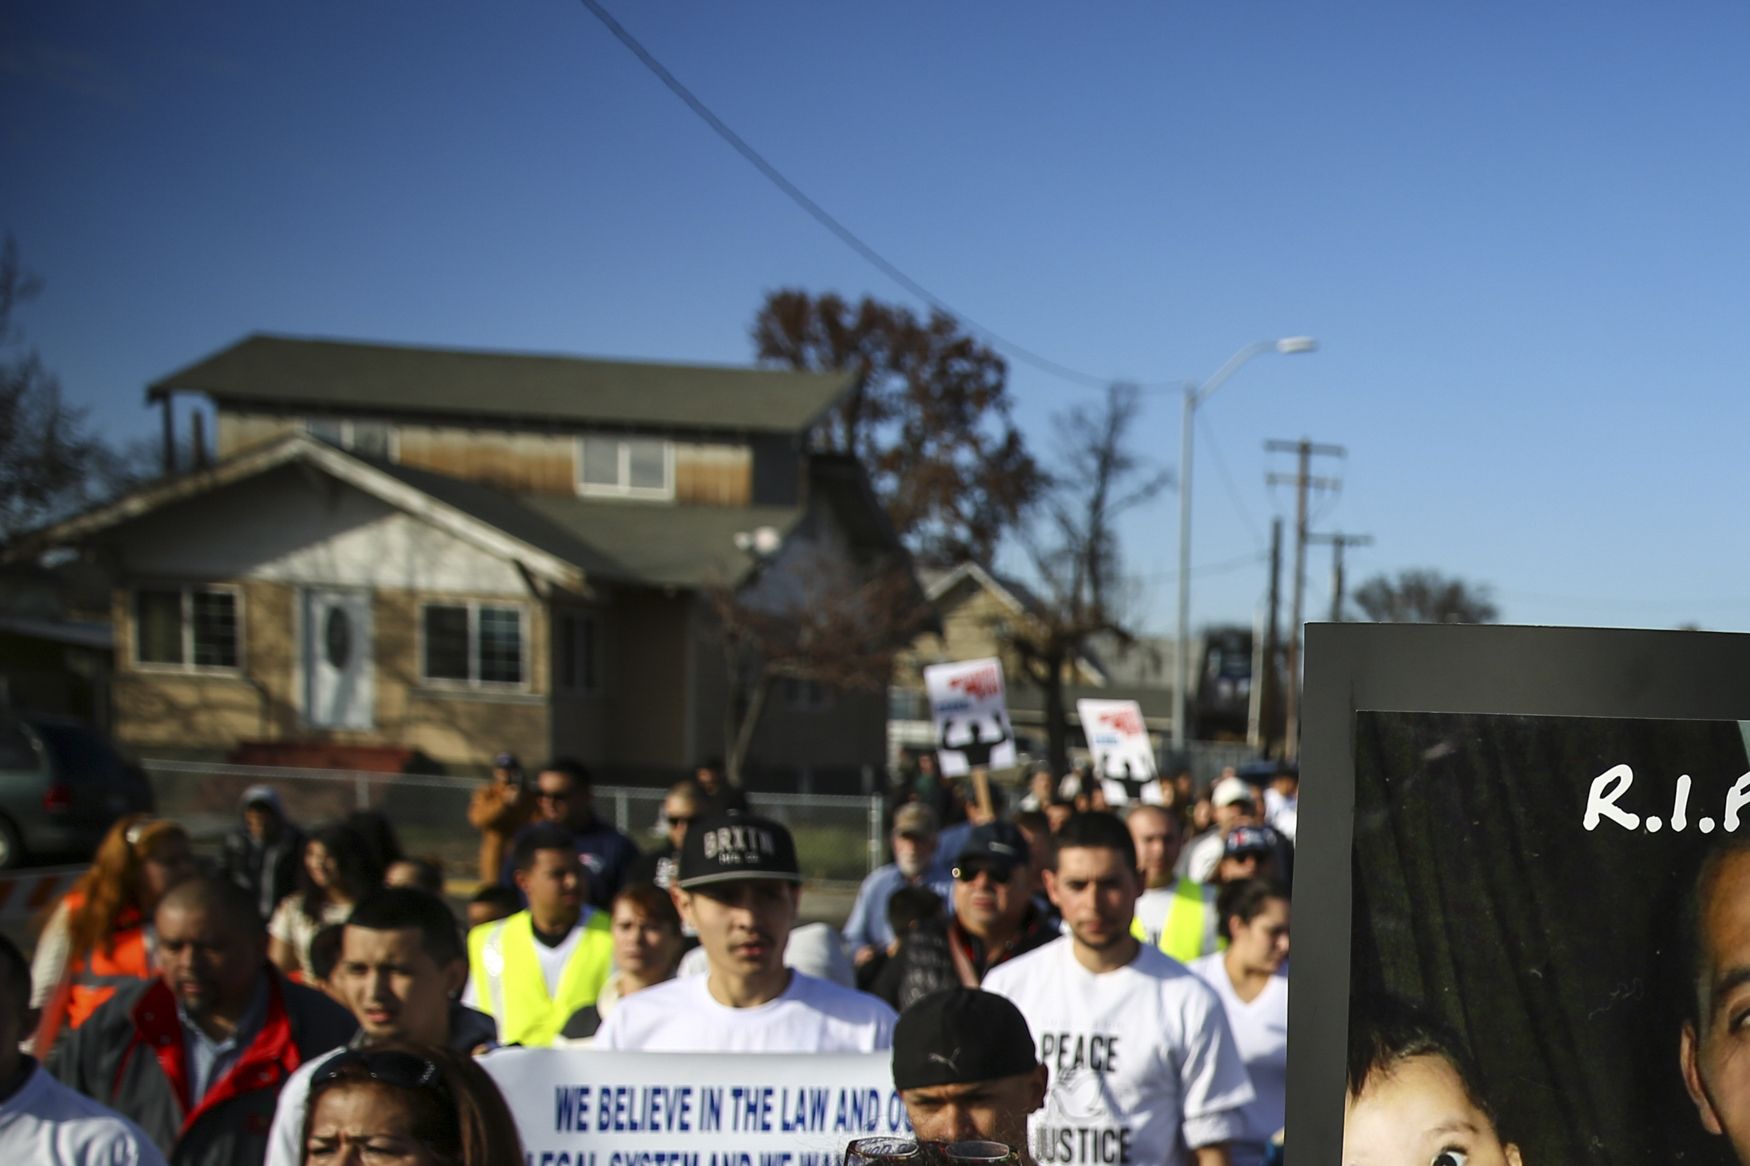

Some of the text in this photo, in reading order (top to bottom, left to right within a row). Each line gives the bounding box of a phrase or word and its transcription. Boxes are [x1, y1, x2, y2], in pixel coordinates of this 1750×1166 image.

[1042, 1034, 1119, 1072] PEACE
[555, 1086, 590, 1132] WE
[597, 1087, 691, 1132] BELIEVE
[700, 1087, 722, 1132] IN
[732, 1088, 774, 1132] THE
[782, 1088, 829, 1132] LAW
[834, 1088, 879, 1132] AND
